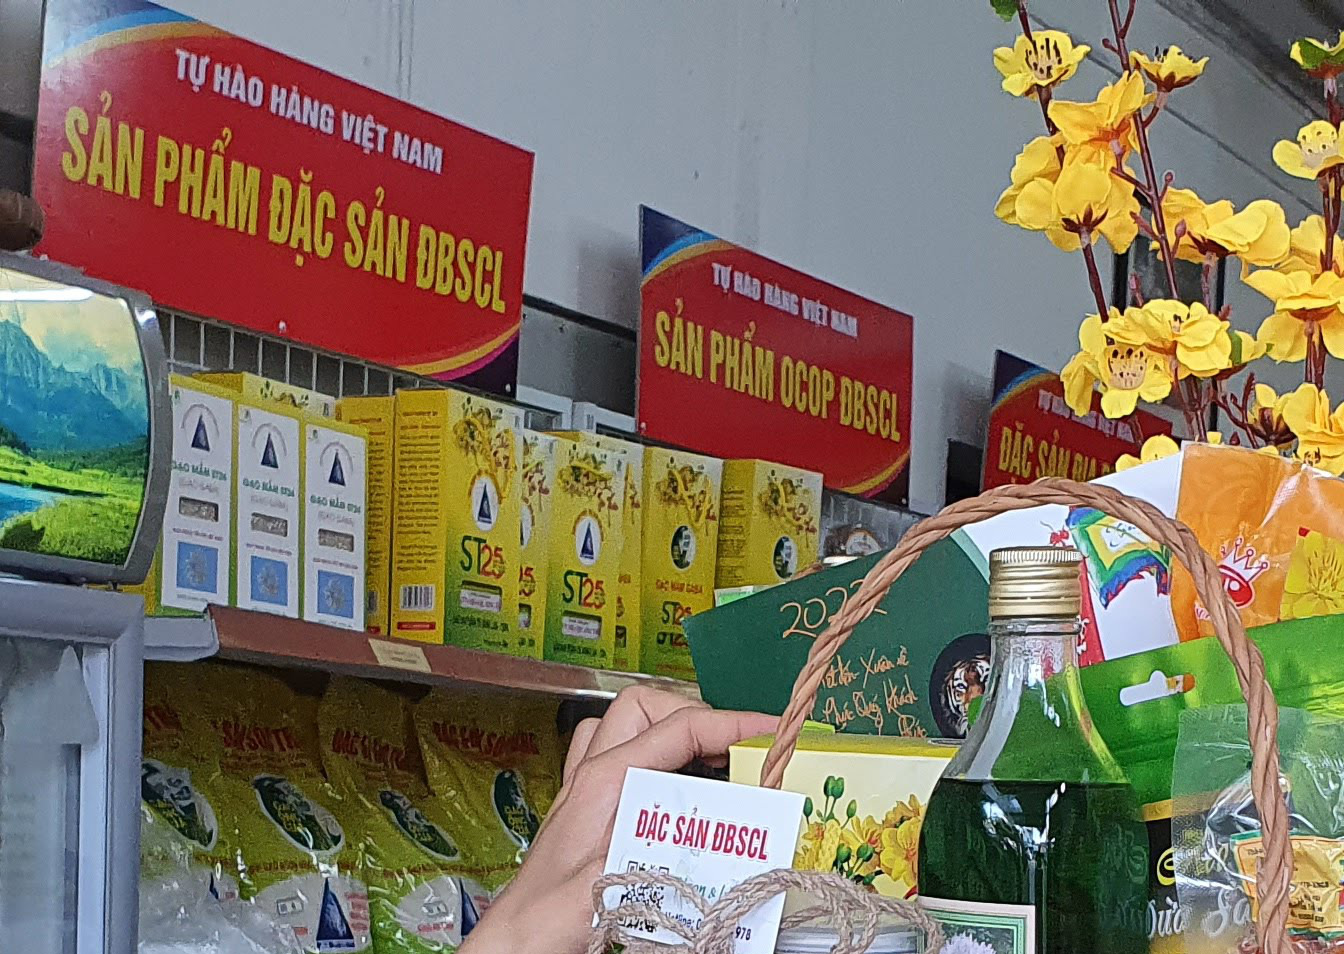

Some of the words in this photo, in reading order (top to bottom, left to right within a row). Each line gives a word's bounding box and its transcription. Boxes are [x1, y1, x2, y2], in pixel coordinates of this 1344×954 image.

[175, 48, 210, 92] TỰ
[213, 64, 263, 108] HÀO
[271, 85, 334, 135] HÀNG
[342, 109, 388, 155] VIỆT
[392, 131, 443, 174] NAM
[62, 91, 145, 200] SẢN
[154, 127, 262, 236] PHẨM
[269, 169, 336, 266] ĐẶC
[345, 186, 410, 282] SẢN
[417, 224, 505, 313] ĐBSCL
[655, 298, 704, 379] SẢN
[710, 321, 775, 402] PHẨM
[781, 356, 835, 419] OCOP
[840, 376, 901, 442] ĐBSCL
[999, 421, 1033, 484] ĐẶC
[460, 535, 506, 580] ST25
[562, 570, 606, 609] ST25
[635, 802, 670, 847] ĐẶC
[673, 807, 710, 849] SẢN
[711, 822, 768, 860] ĐBSCL
